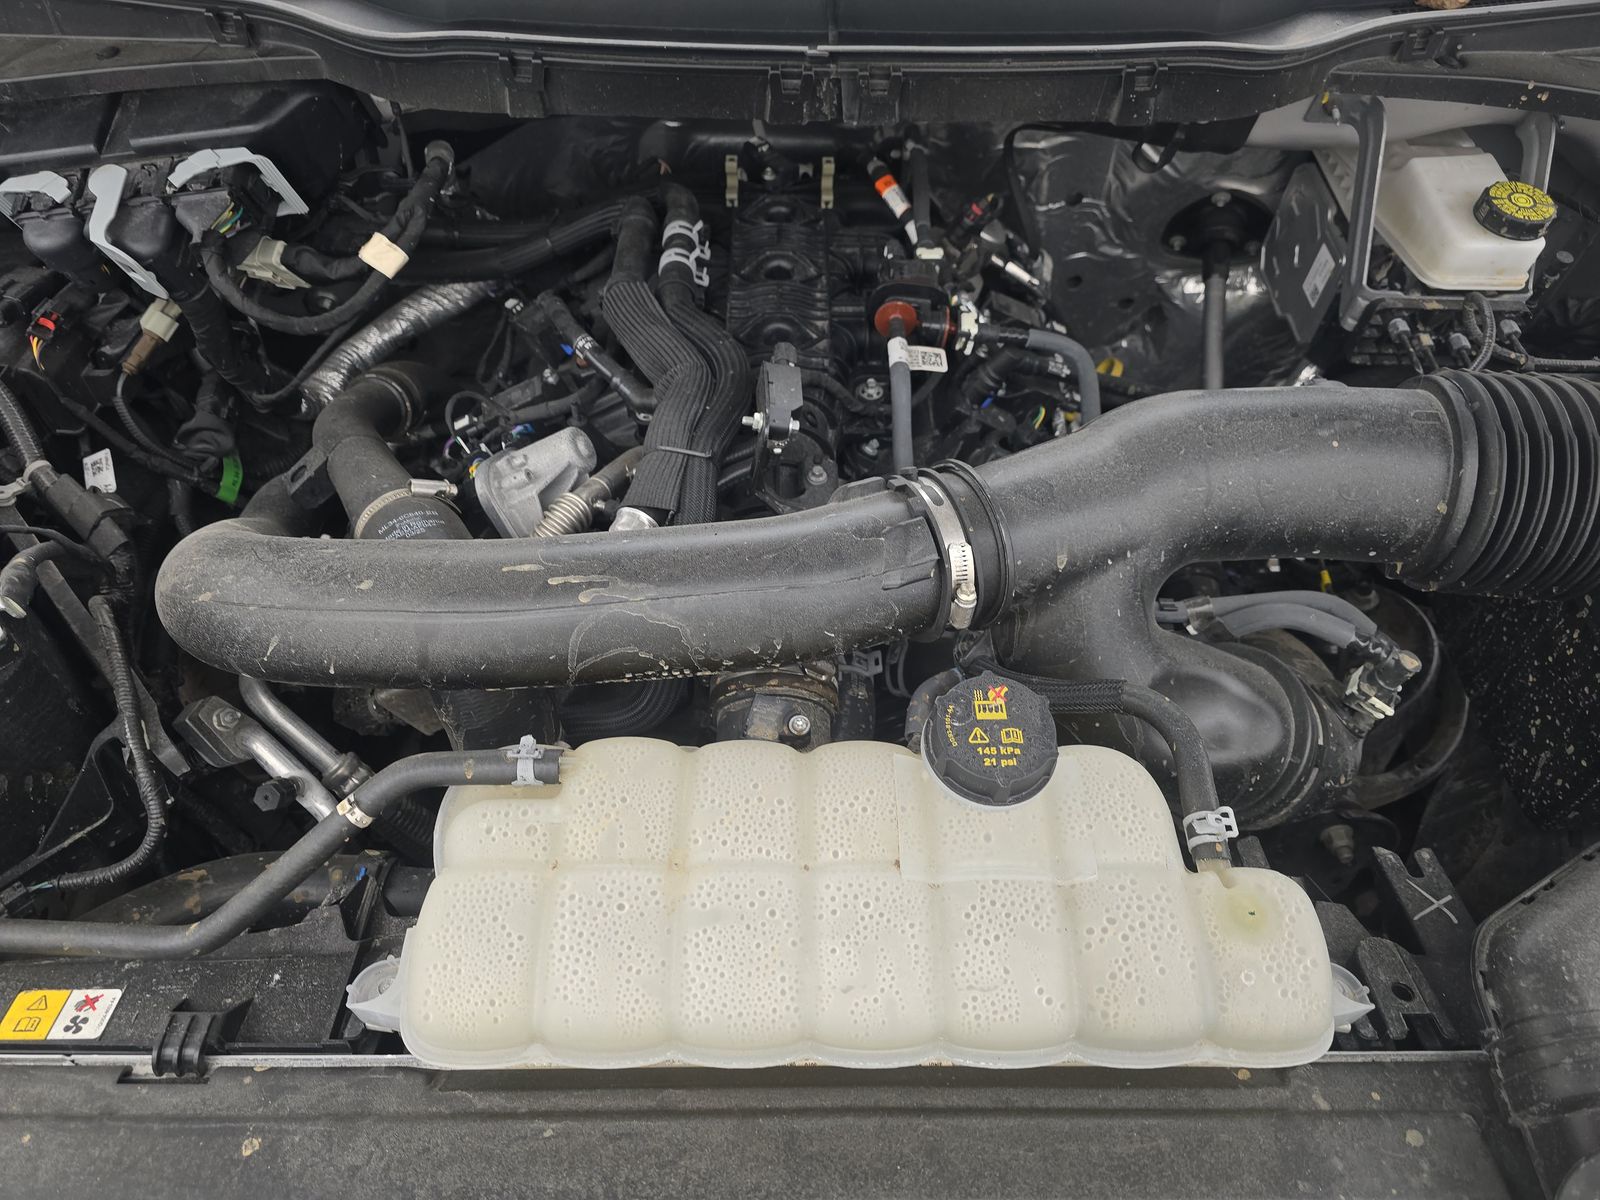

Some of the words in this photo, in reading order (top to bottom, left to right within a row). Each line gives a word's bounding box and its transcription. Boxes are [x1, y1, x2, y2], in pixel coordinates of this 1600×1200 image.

[977, 746, 997, 755] 145
[1001, 746, 1021, 755] kPa
[983, 757, 997, 767] 21
[1001, 757, 1017, 767] psi
